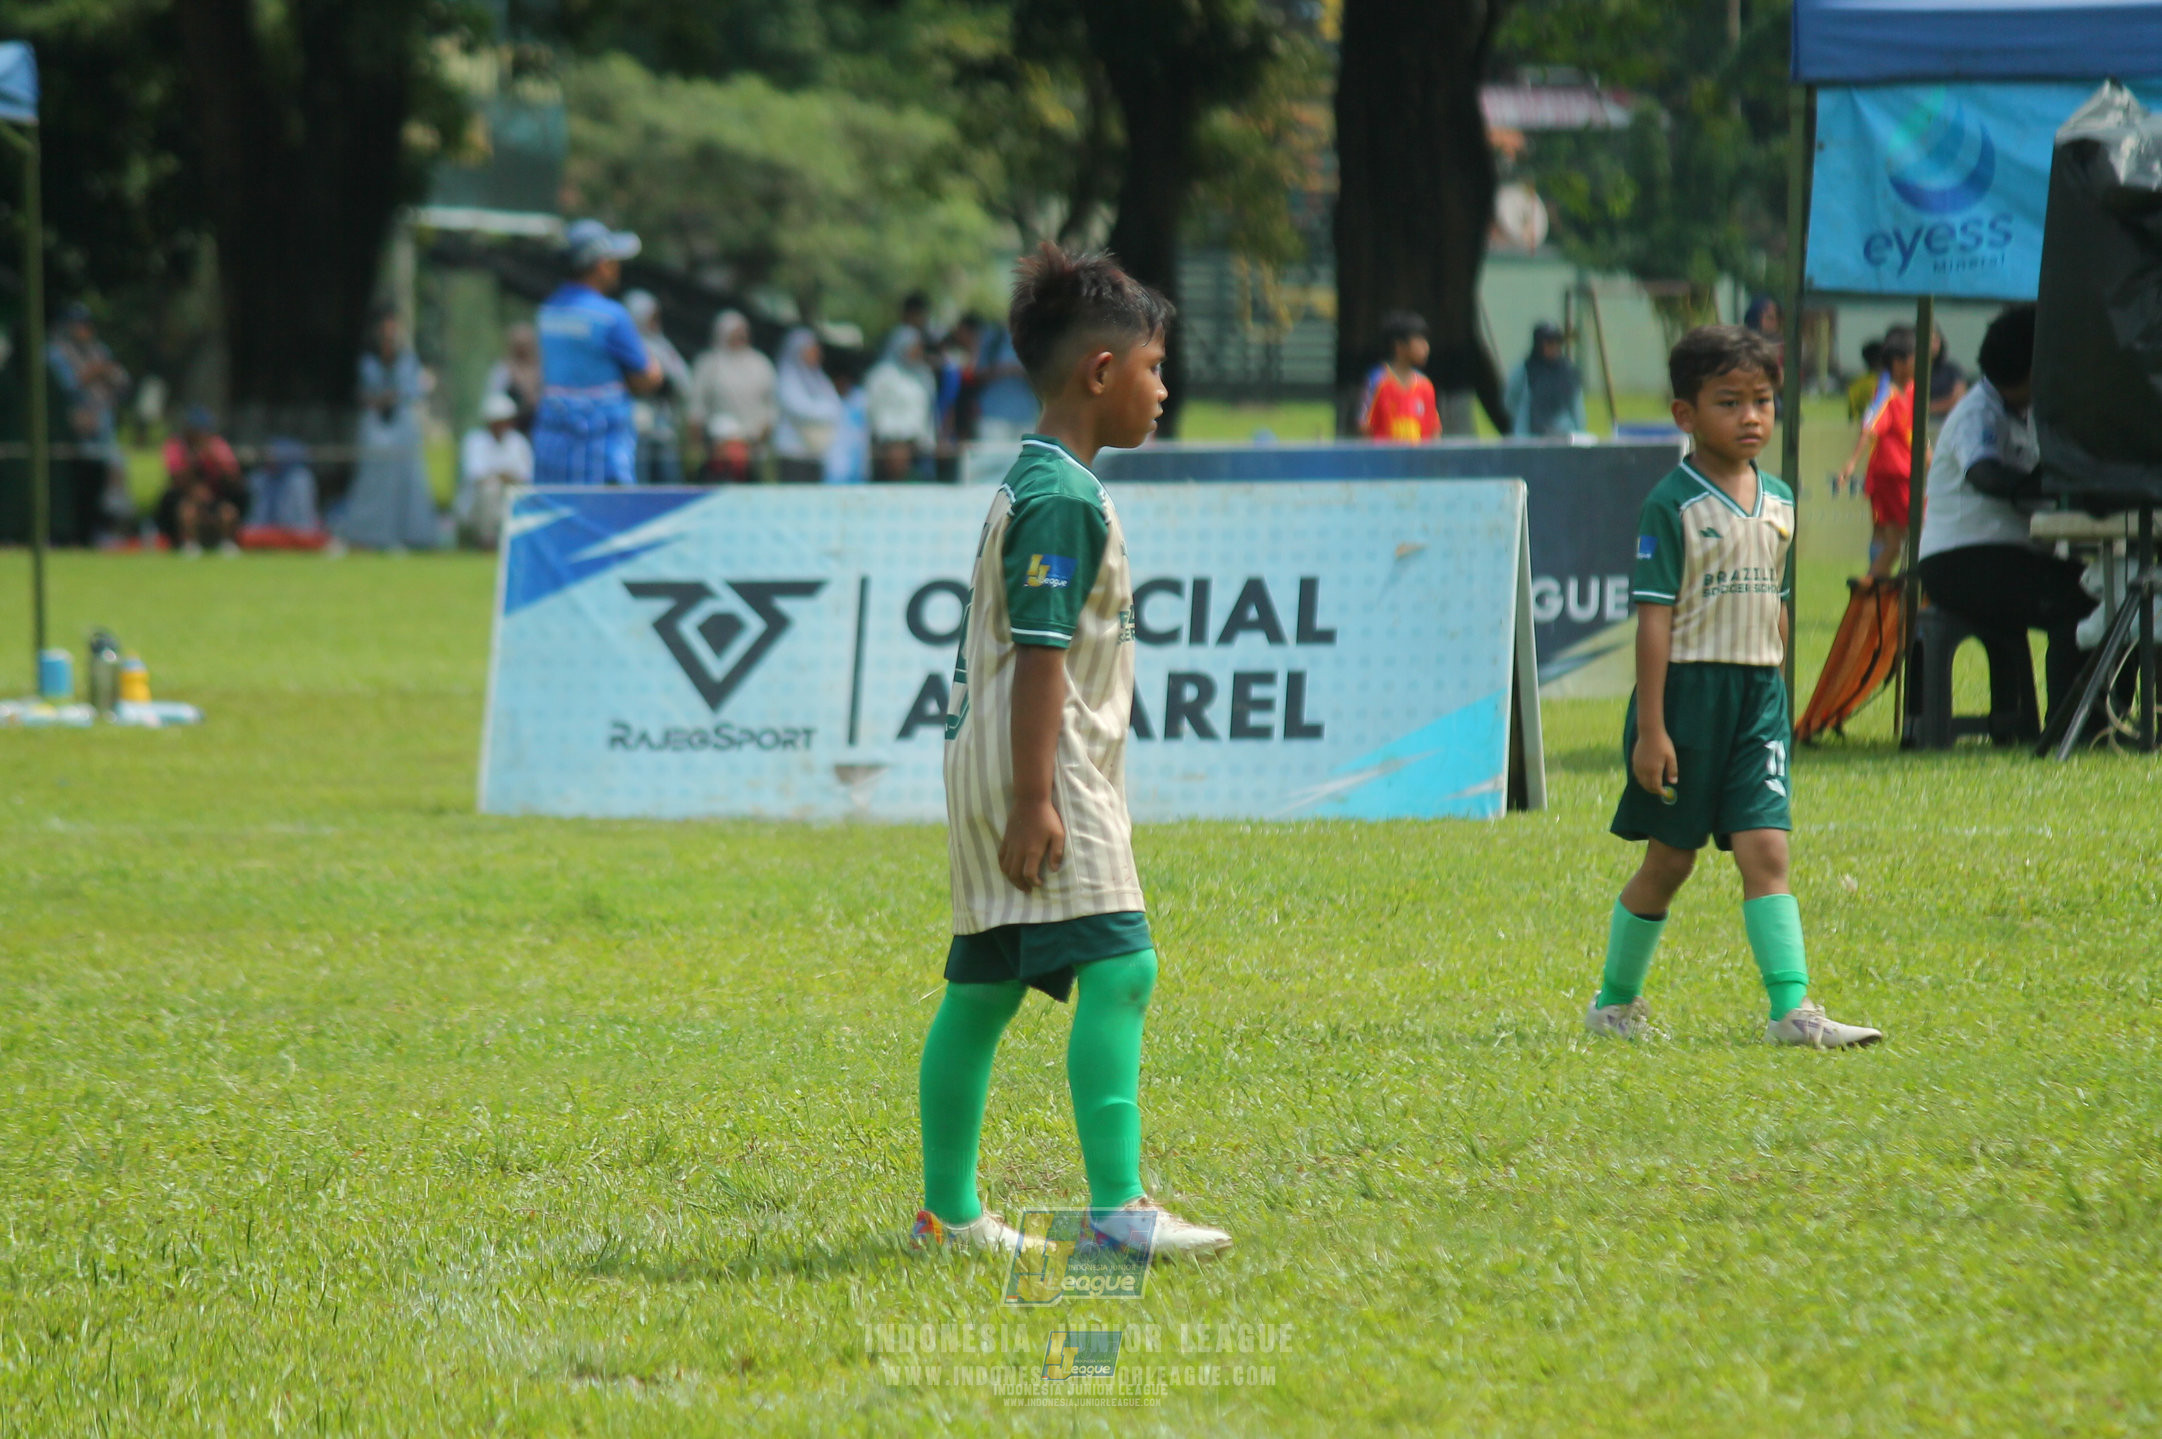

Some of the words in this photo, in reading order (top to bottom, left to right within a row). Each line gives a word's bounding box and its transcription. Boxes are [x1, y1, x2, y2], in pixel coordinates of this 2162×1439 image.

[1863, 212, 2014, 278] eyess
[905, 576, 1338, 647] OCIAL
[1531, 574, 1630, 622] GUE
[896, 671, 1326, 741] AREL
